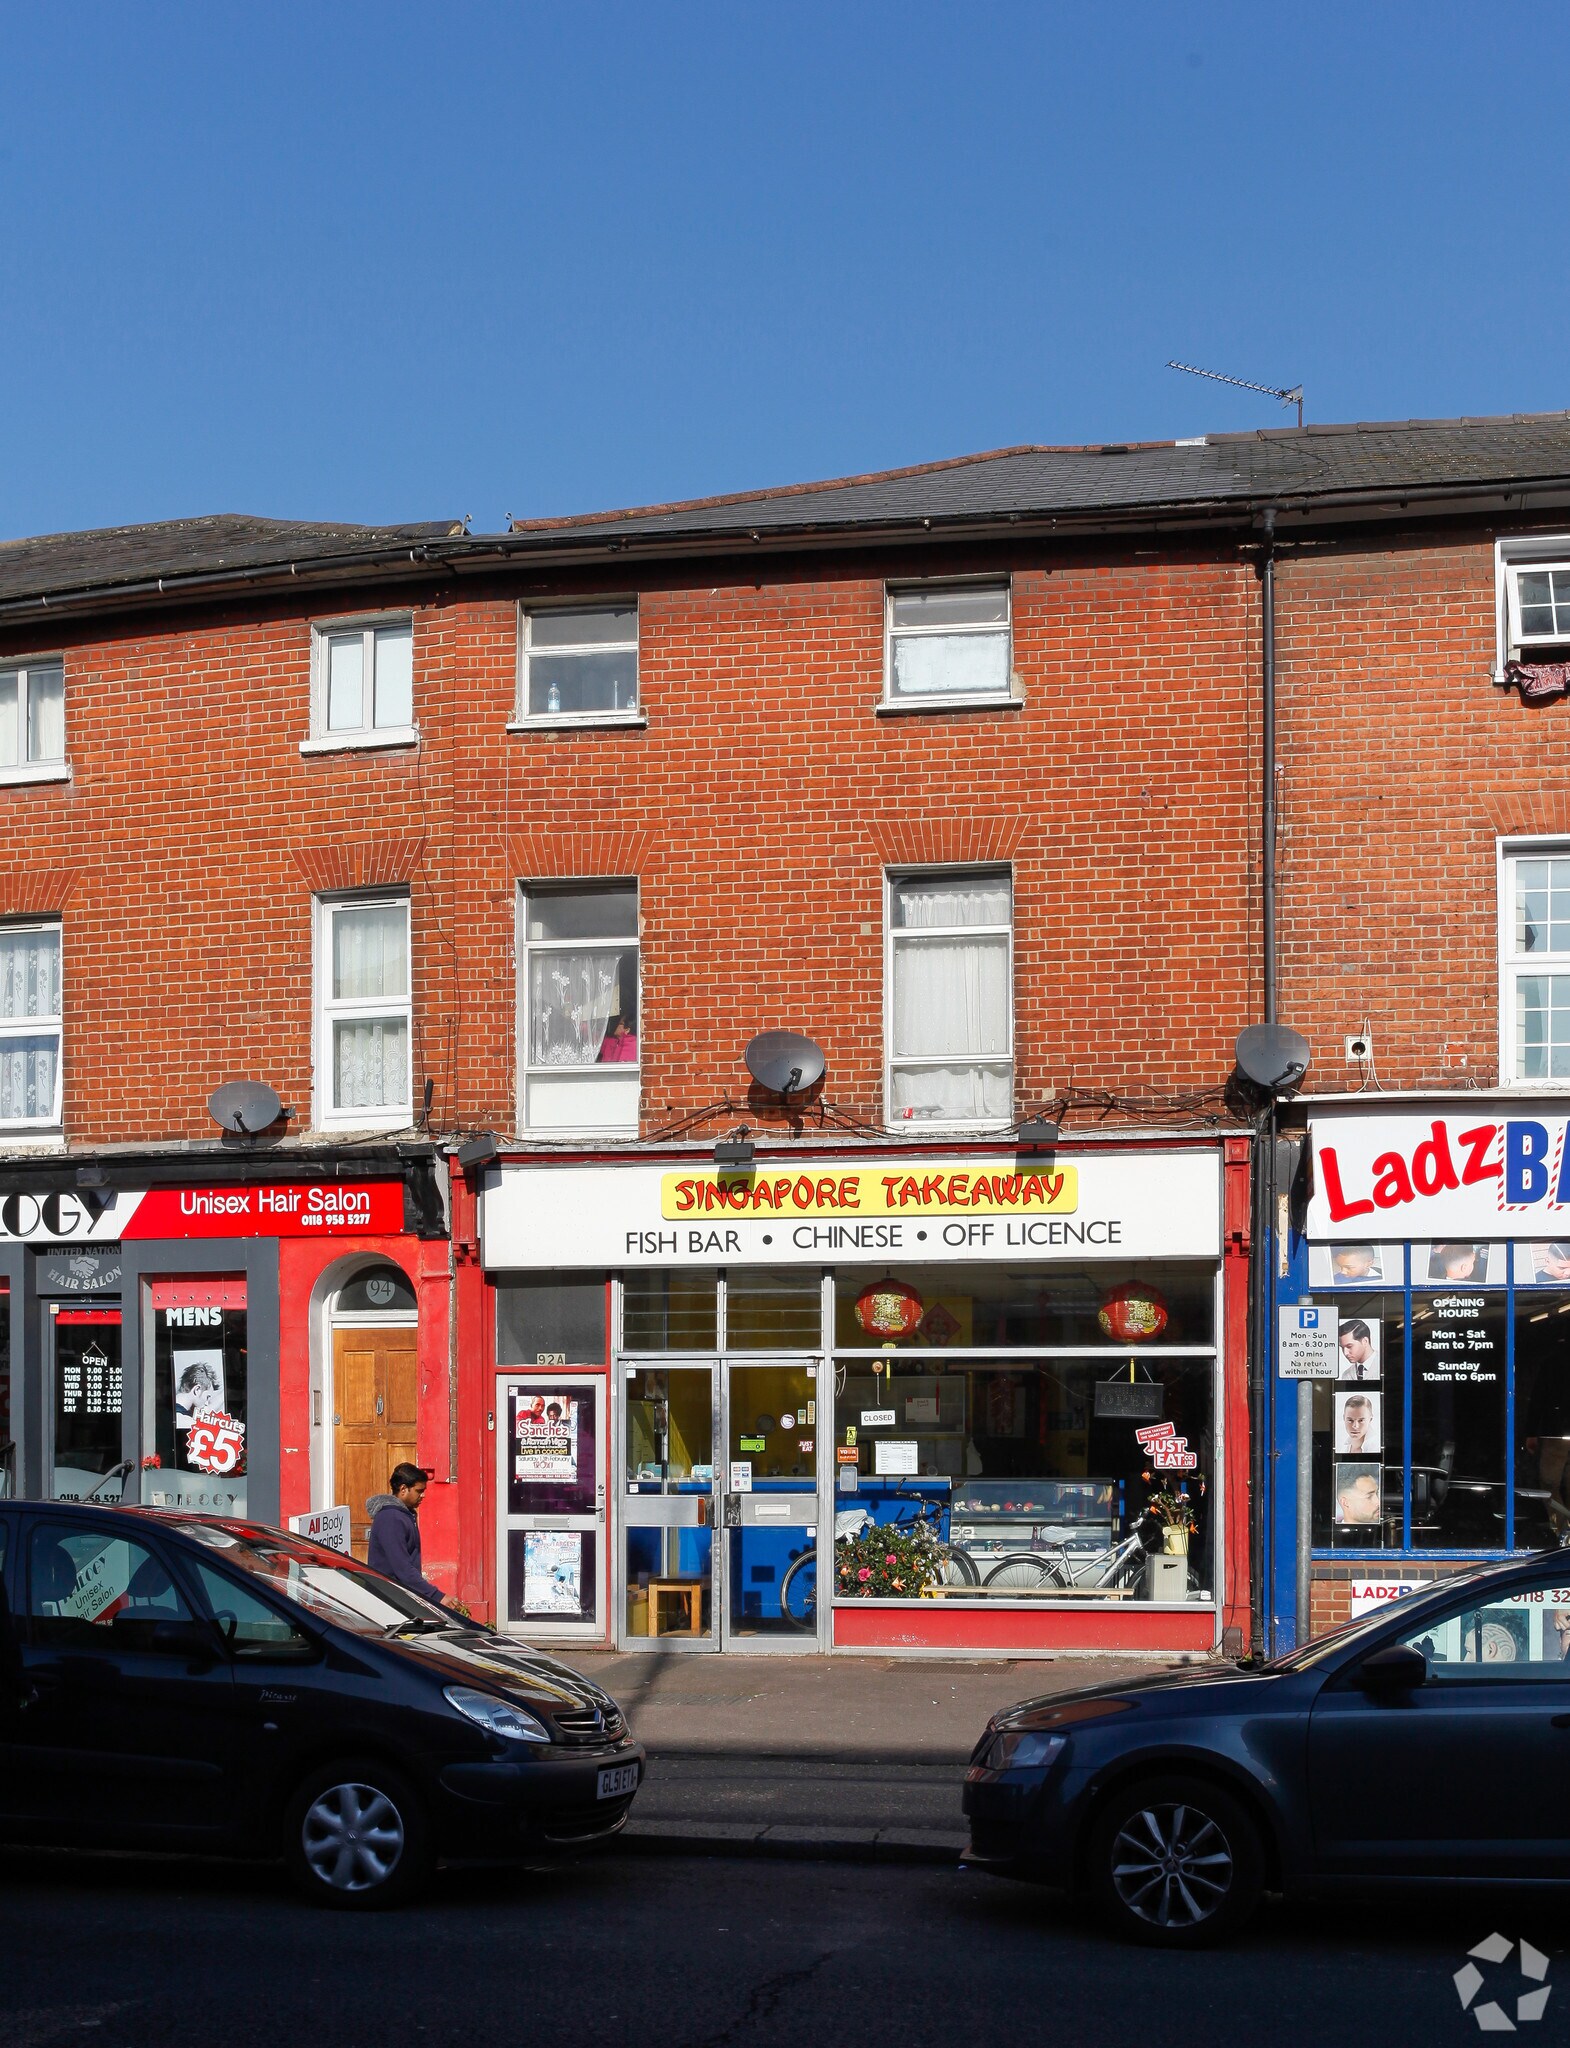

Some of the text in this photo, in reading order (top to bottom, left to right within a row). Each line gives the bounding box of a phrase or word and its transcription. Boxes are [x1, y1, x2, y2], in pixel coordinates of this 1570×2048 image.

[674, 1172, 1065, 1212] SINGAPORE TAKEAWAY
[180, 1187, 370, 1215] Unisex Hair Salon
[0, 1190, 117, 1237] OGY
[301, 1213, 370, 1226] 0118 958 5277
[625, 1221, 1122, 1254] FISH BAR CHINESE OFF LICENCE
[47, 1265, 122, 1290] HAIR SALON
[370, 1279, 391, 1297] 94
[1433, 1298, 1485, 1307] OPENING
[166, 1307, 222, 1327] MENS
[1303, 1310, 1316, 1327] P
[1438, 1309, 1479, 1318] HOURS
[1432, 1330, 1456, 1339] Mon
[1466, 1330, 1486, 1339] Sat
[1424, 1340, 1494, 1351] 8am to 7pm
[82, 1355, 108, 1367] OPEN
[538, 1354, 565, 1366] 92A
[1437, 1361, 1481, 1372] Sunday
[1422, 1371, 1497, 1382] 10am to 6pm
[64, 1405, 77, 1413] SAT
[87, 1405, 101, 1413] 8.30
[107, 1405, 122, 1413] 5.00
[193, 1407, 245, 1434] Haircuts
[519, 1419, 569, 1437] Sanchez
[188, 1428, 239, 1472] £5
[1147, 1440, 1184, 1452] JUST
[1157, 1454, 1182, 1466] EAT
[308, 1513, 343, 1535] All Body
[76, 1581, 104, 1610] Unisex
[91, 1586, 115, 1611] Salon
